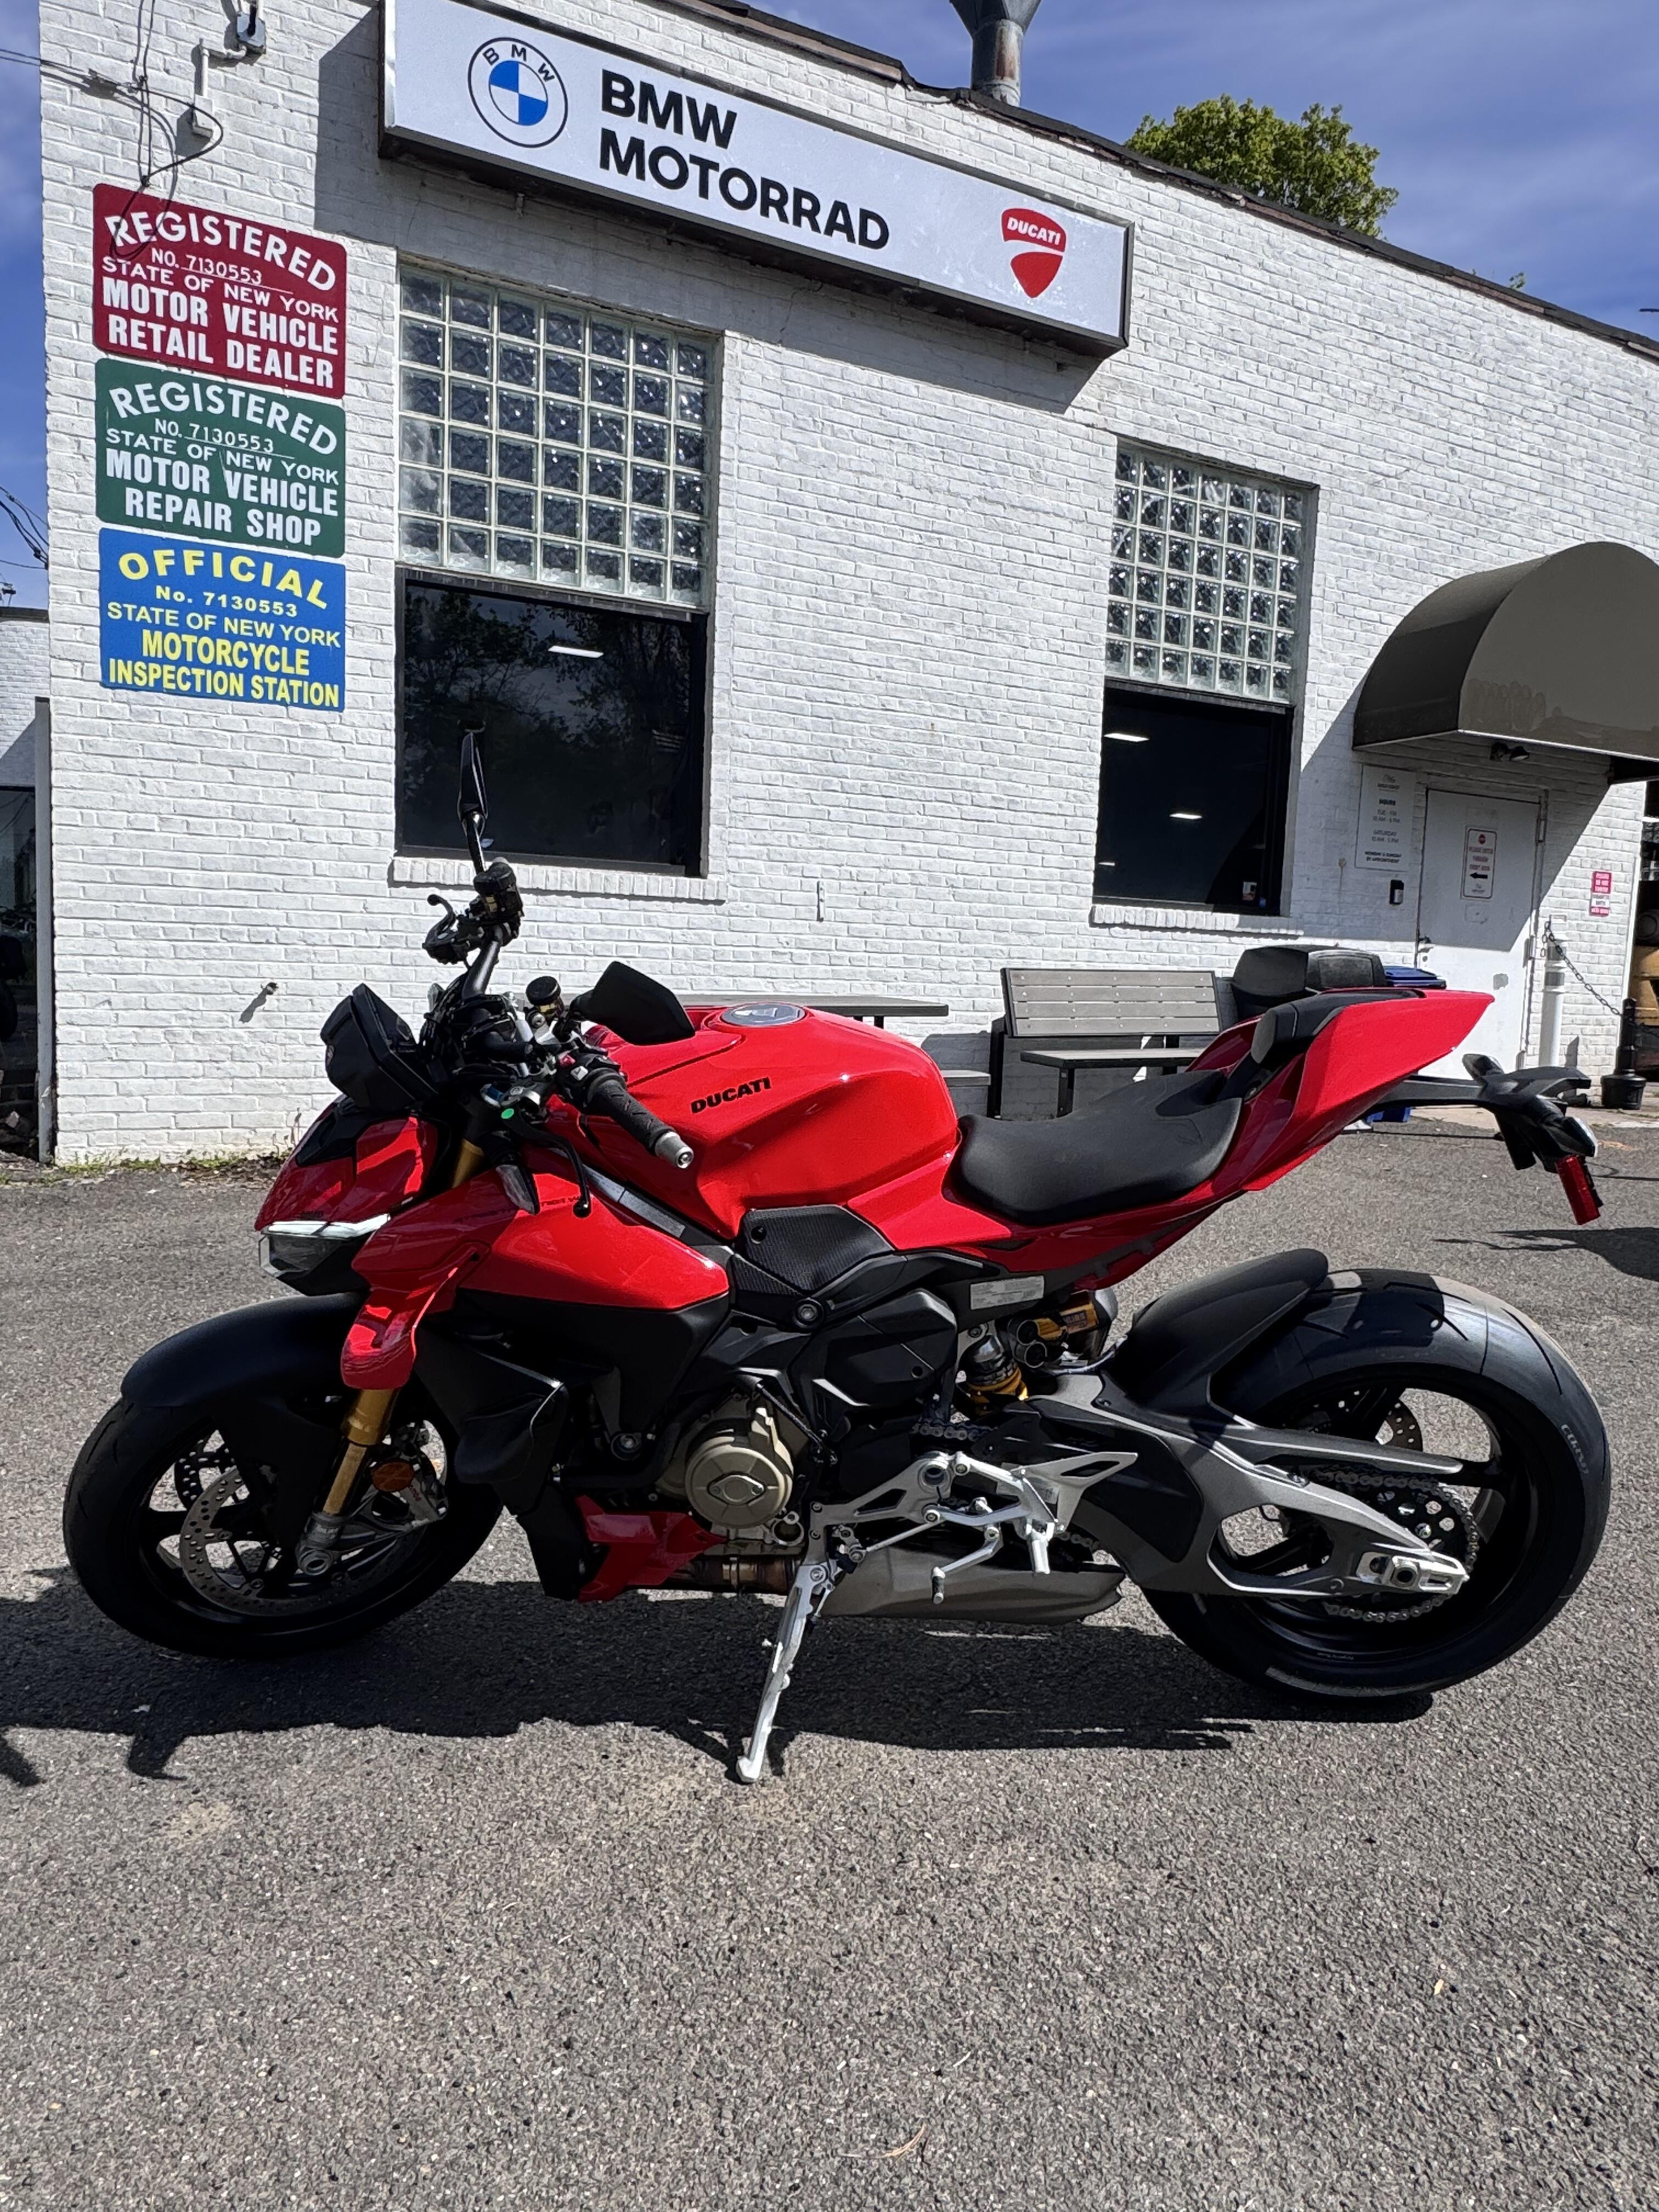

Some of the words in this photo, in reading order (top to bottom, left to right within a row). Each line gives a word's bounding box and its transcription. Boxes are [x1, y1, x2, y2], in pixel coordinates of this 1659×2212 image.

[482, 44, 555, 82] BMW
[601, 69, 737, 150] BMW
[599, 127, 889, 250] MOTORRAD
[105, 211, 336, 291] REGISTERED
[1007, 217, 1060, 245] DUCATI
[102, 256, 173, 285] STATE
[184, 274, 213, 292] OF
[224, 282, 270, 307] NEW
[280, 295, 339, 323] YORK
[151, 247, 180, 268] NO.
[186, 255, 262, 285] 7130553
[102, 276, 208, 327] MOTOR
[222, 302, 338, 355] VEHICLE
[109, 314, 213, 364] RETAIL
[227, 338, 333, 388] DEALER
[109, 381, 337, 455] REGISTERED
[155, 419, 182, 438] NO.
[189, 423, 274, 453] 7130553
[106, 428, 176, 455] STATE
[187, 443, 216, 461] OF
[226, 450, 272, 472] NEW
[281, 460, 339, 486] YORK
[106, 448, 210, 494] MOTOR
[223, 469, 338, 516] VEHICLE
[126, 487, 232, 532] REPAIR
[246, 509, 321, 545] SHOP
[119, 549, 327, 610] OFFICIAL
[156, 585, 193, 603] No.
[203, 591, 297, 617] 7130553
[107, 601, 179, 627] STATE
[186, 612, 217, 630] OF
[224, 617, 274, 639] NEW
[279, 624, 341, 648] YORK
[142, 629, 309, 676] MOTORCYCLE
[109, 658, 243, 697] INSPECTION
[251, 674, 338, 708] STATION
[691, 1077, 772, 1114] DUCATI
